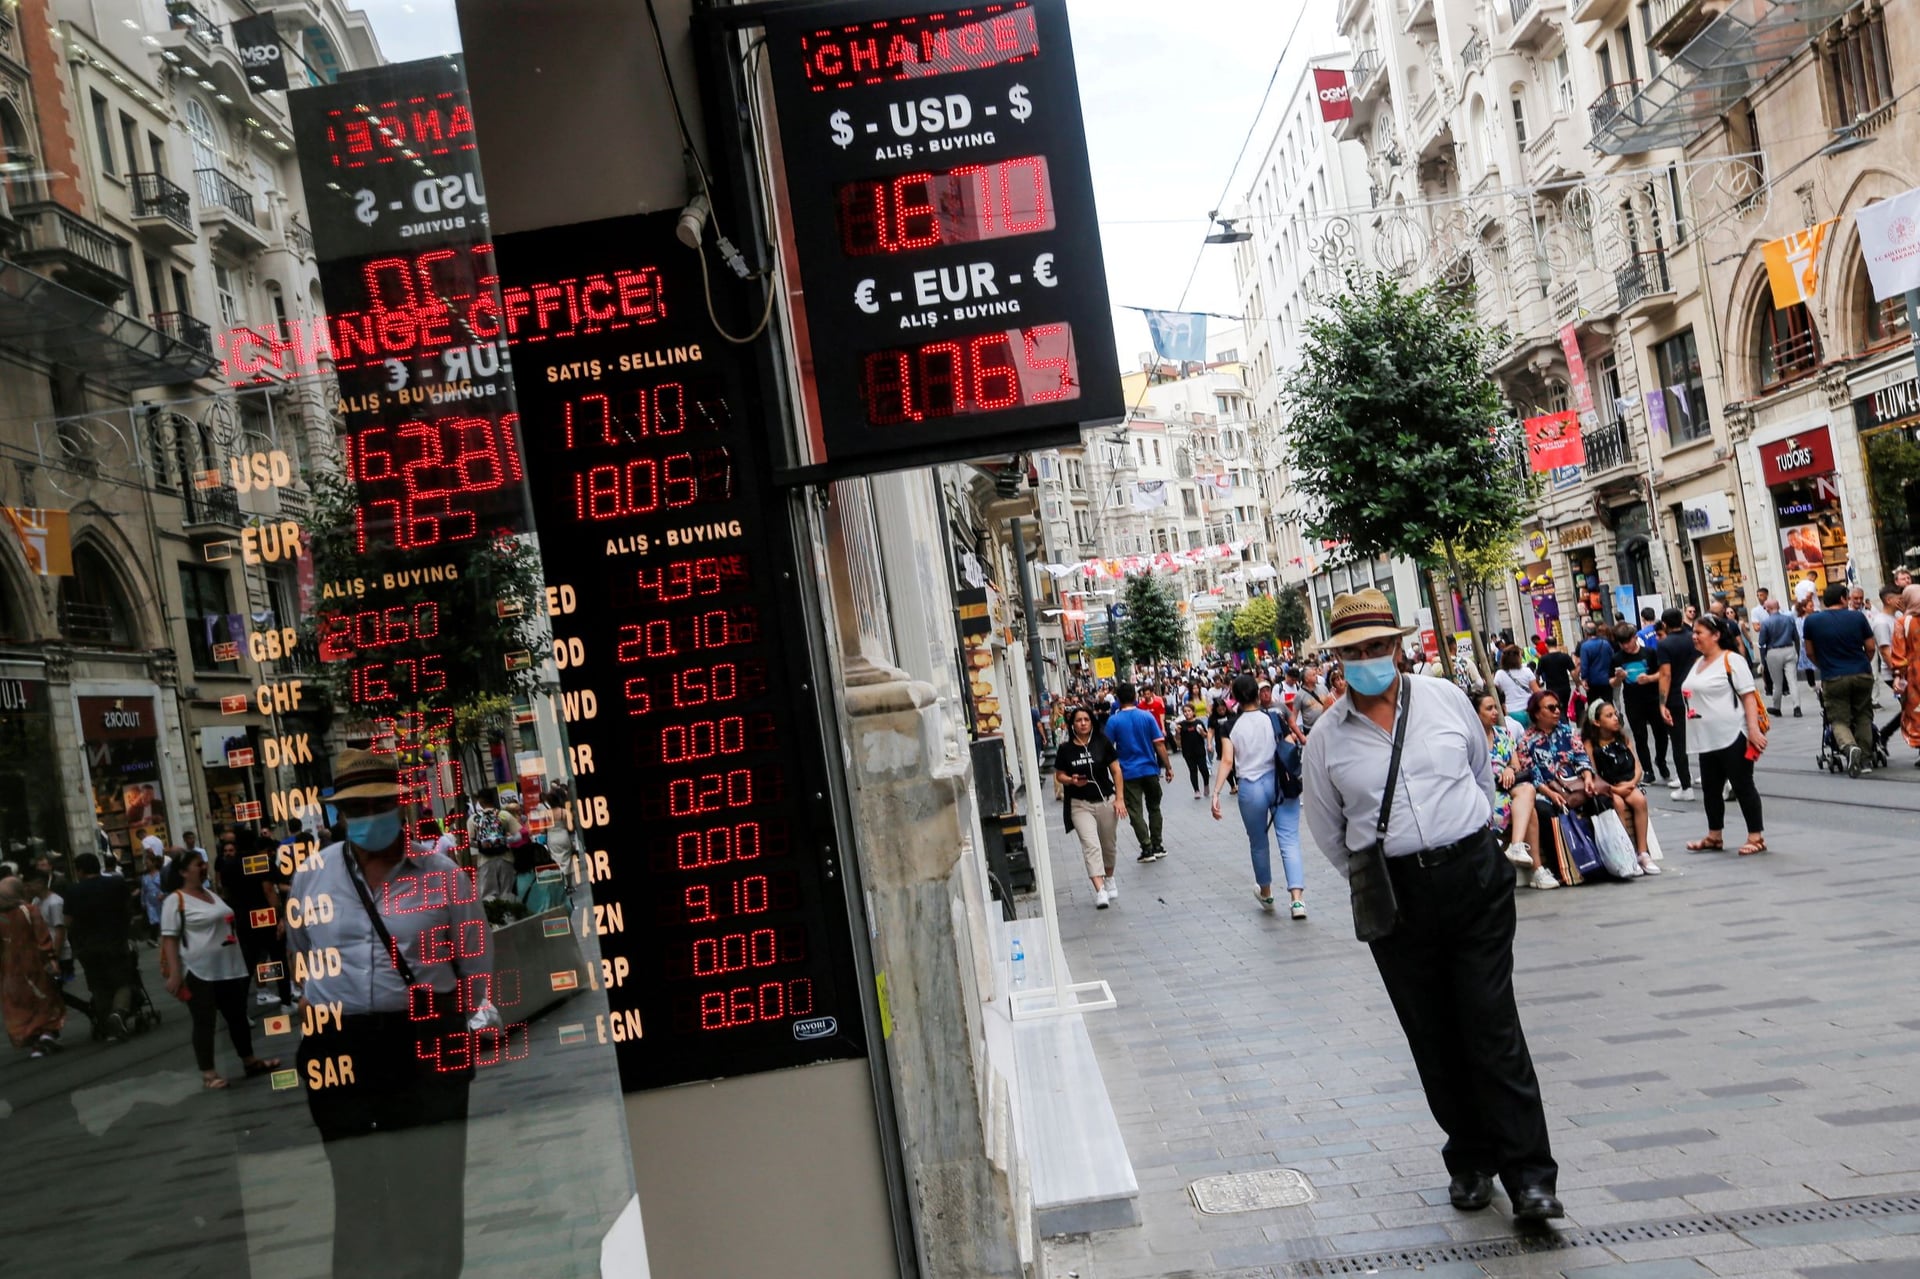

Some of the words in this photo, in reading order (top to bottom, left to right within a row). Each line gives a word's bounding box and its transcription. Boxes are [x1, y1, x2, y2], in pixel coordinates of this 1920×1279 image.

[816, 18, 1020, 76] CHANGE
[831, 109, 854, 149] $
[889, 93, 971, 136] USD
[1009, 83, 1032, 124] $
[875, 143, 914, 161] ALIŞ
[929, 132, 996, 153] BUYING
[854, 278, 879, 315] €
[913, 261, 999, 307] EUR
[1033, 253, 1058, 288] €
[232, 304, 452, 374] CHANGE
[467, 273, 653, 338] OFFICE
[900, 311, 938, 329] ALIŞ
[953, 300, 1021, 320] BUYING
[546, 358, 602, 383] SATIŞ
[619, 345, 703, 372] SELLING
[338, 392, 380, 414] ALIŞ
[398, 379, 473, 406] BUYING
[229, 450, 291, 494] USD
[1775, 448, 1811, 473] TUDORS
[1778, 503, 1813, 516] TUDORS
[240, 521, 303, 566] EUR
[605, 534, 649, 556] ALIŞ
[666, 521, 742, 545] BUYING
[323, 577, 365, 599] ALIŞ
[383, 563, 458, 590] BUYING
[545, 584, 577, 617] ED
[248, 628, 298, 663] GBP
[553, 637, 585, 671] OD
[256, 680, 303, 716] CHF
[264, 733, 313, 769] DKK
[271, 786, 322, 822] NOK
[279, 839, 325, 876] SEK
[285, 893, 334, 930] CAD
[294, 947, 342, 982] AUD
[301, 1001, 343, 1037] JPY
[307, 1054, 356, 1091] SAR
